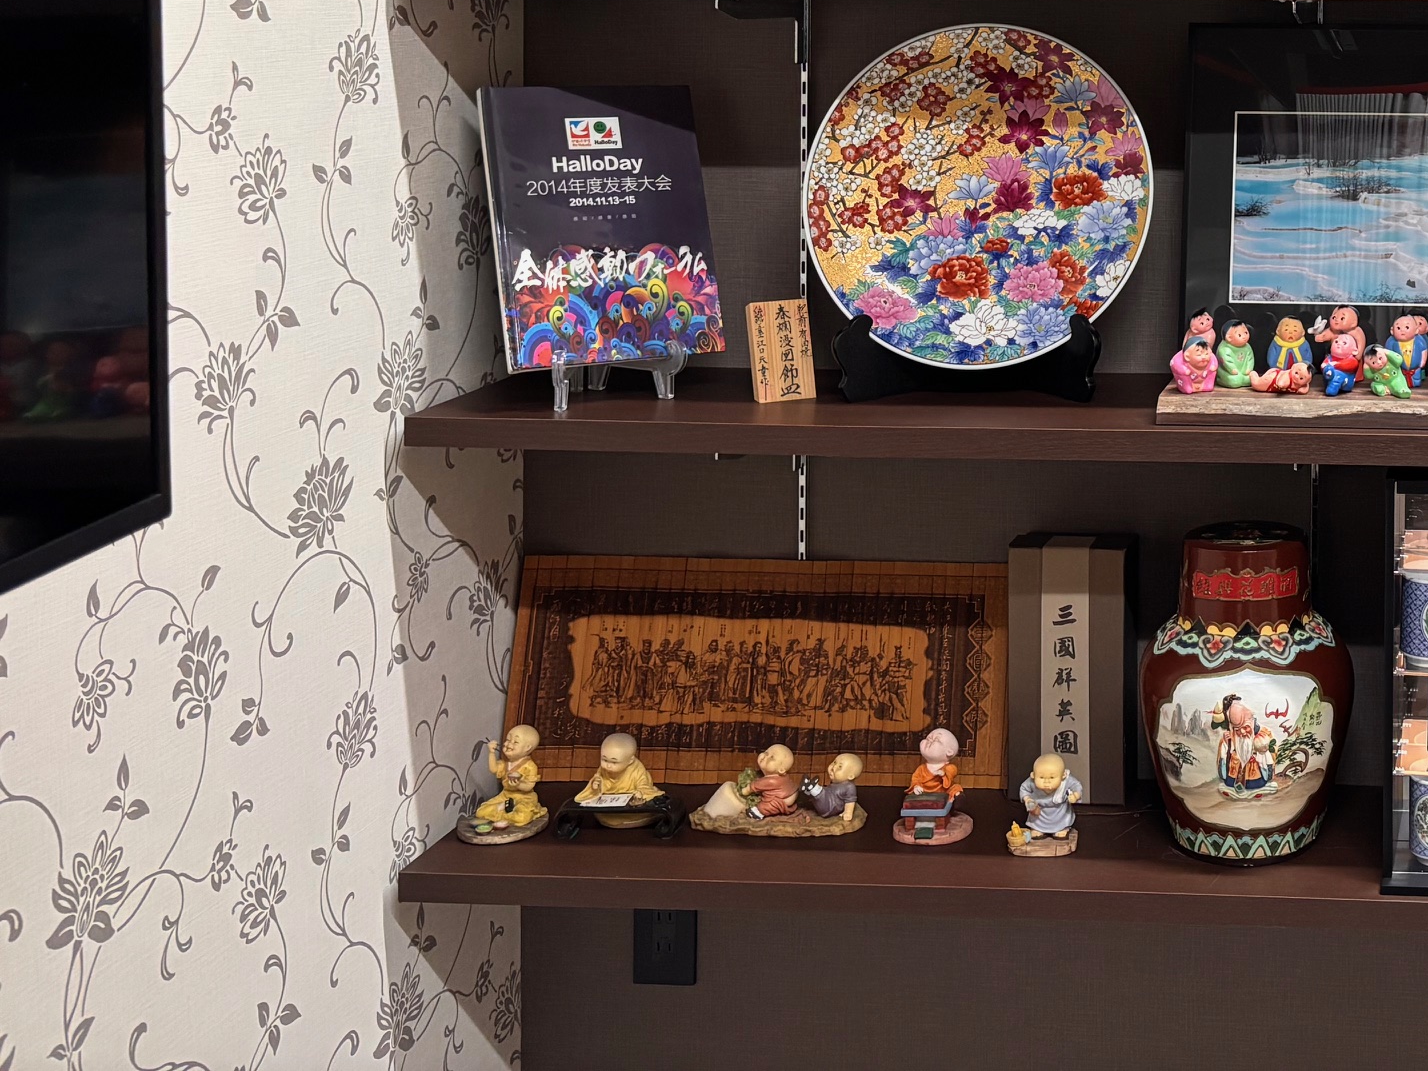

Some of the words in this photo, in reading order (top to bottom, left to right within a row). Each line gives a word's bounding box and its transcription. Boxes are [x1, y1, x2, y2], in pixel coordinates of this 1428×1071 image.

[551, 155, 643, 174] HalloDay
[526, 174, 672, 197] 2014年度发表大会
[512, 245, 707, 294] 全体感動フォーラム
[1052, 604, 1078, 755] 三國群英圖
